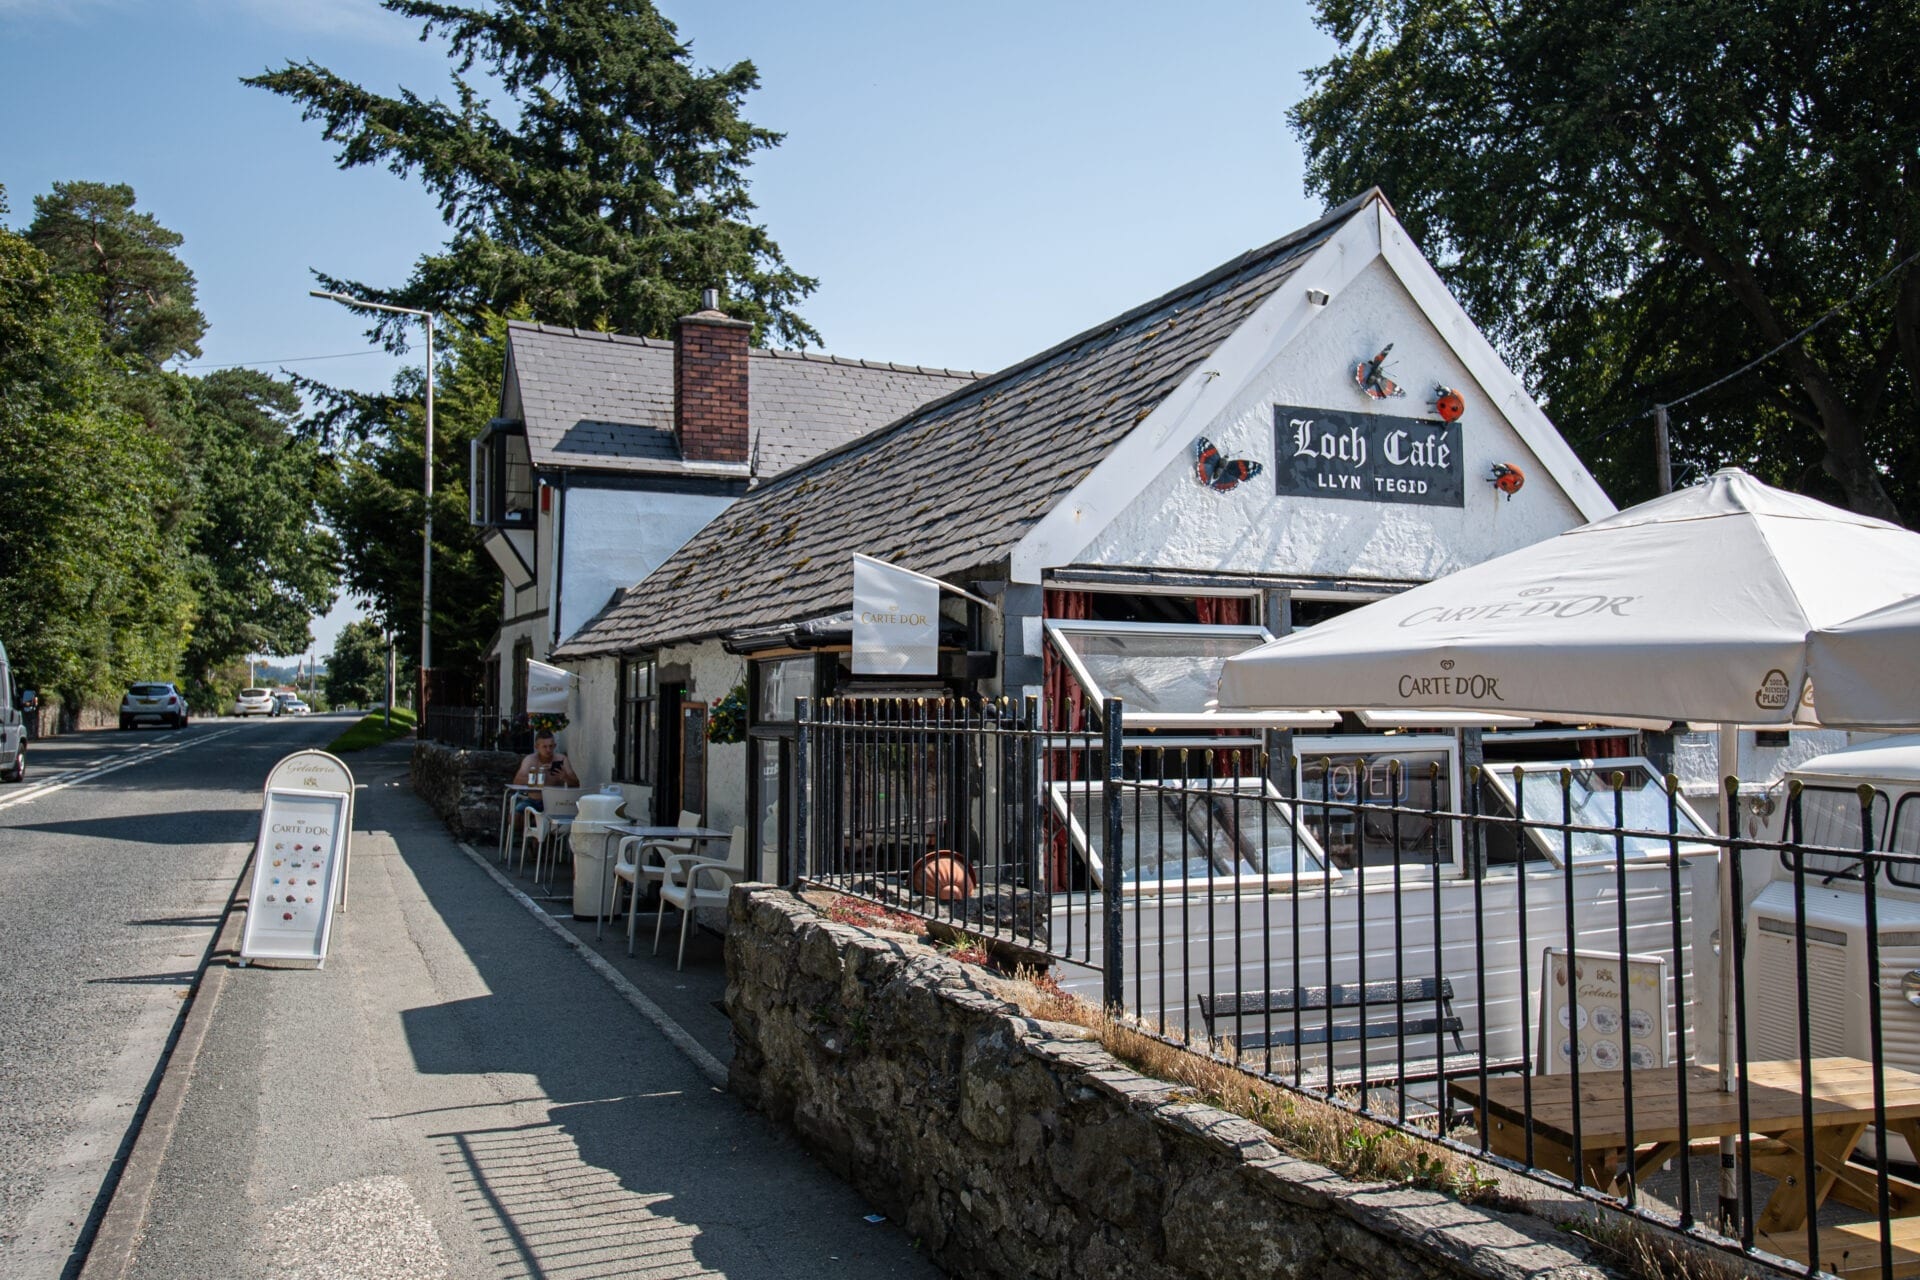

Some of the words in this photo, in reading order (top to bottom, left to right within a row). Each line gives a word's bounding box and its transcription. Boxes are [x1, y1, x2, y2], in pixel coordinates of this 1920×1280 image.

[1290, 419, 1366, 469] Loch
[1383, 429, 1451, 469] Café
[1318, 473, 1361, 490] LLYN
[1374, 477, 1428, 494] TEGID
[861, 611, 896, 625] CARTE
[900, 613, 930, 626] D'OR
[1398, 602, 1519, 628] CARTE
[1398, 674, 1451, 699] CARTE
[1455, 674, 1505, 701] D'OR
[1763, 694, 1788, 704] PLASTIC
[1332, 764, 1404, 796] OPEN
[271, 823, 302, 834] CARTE
